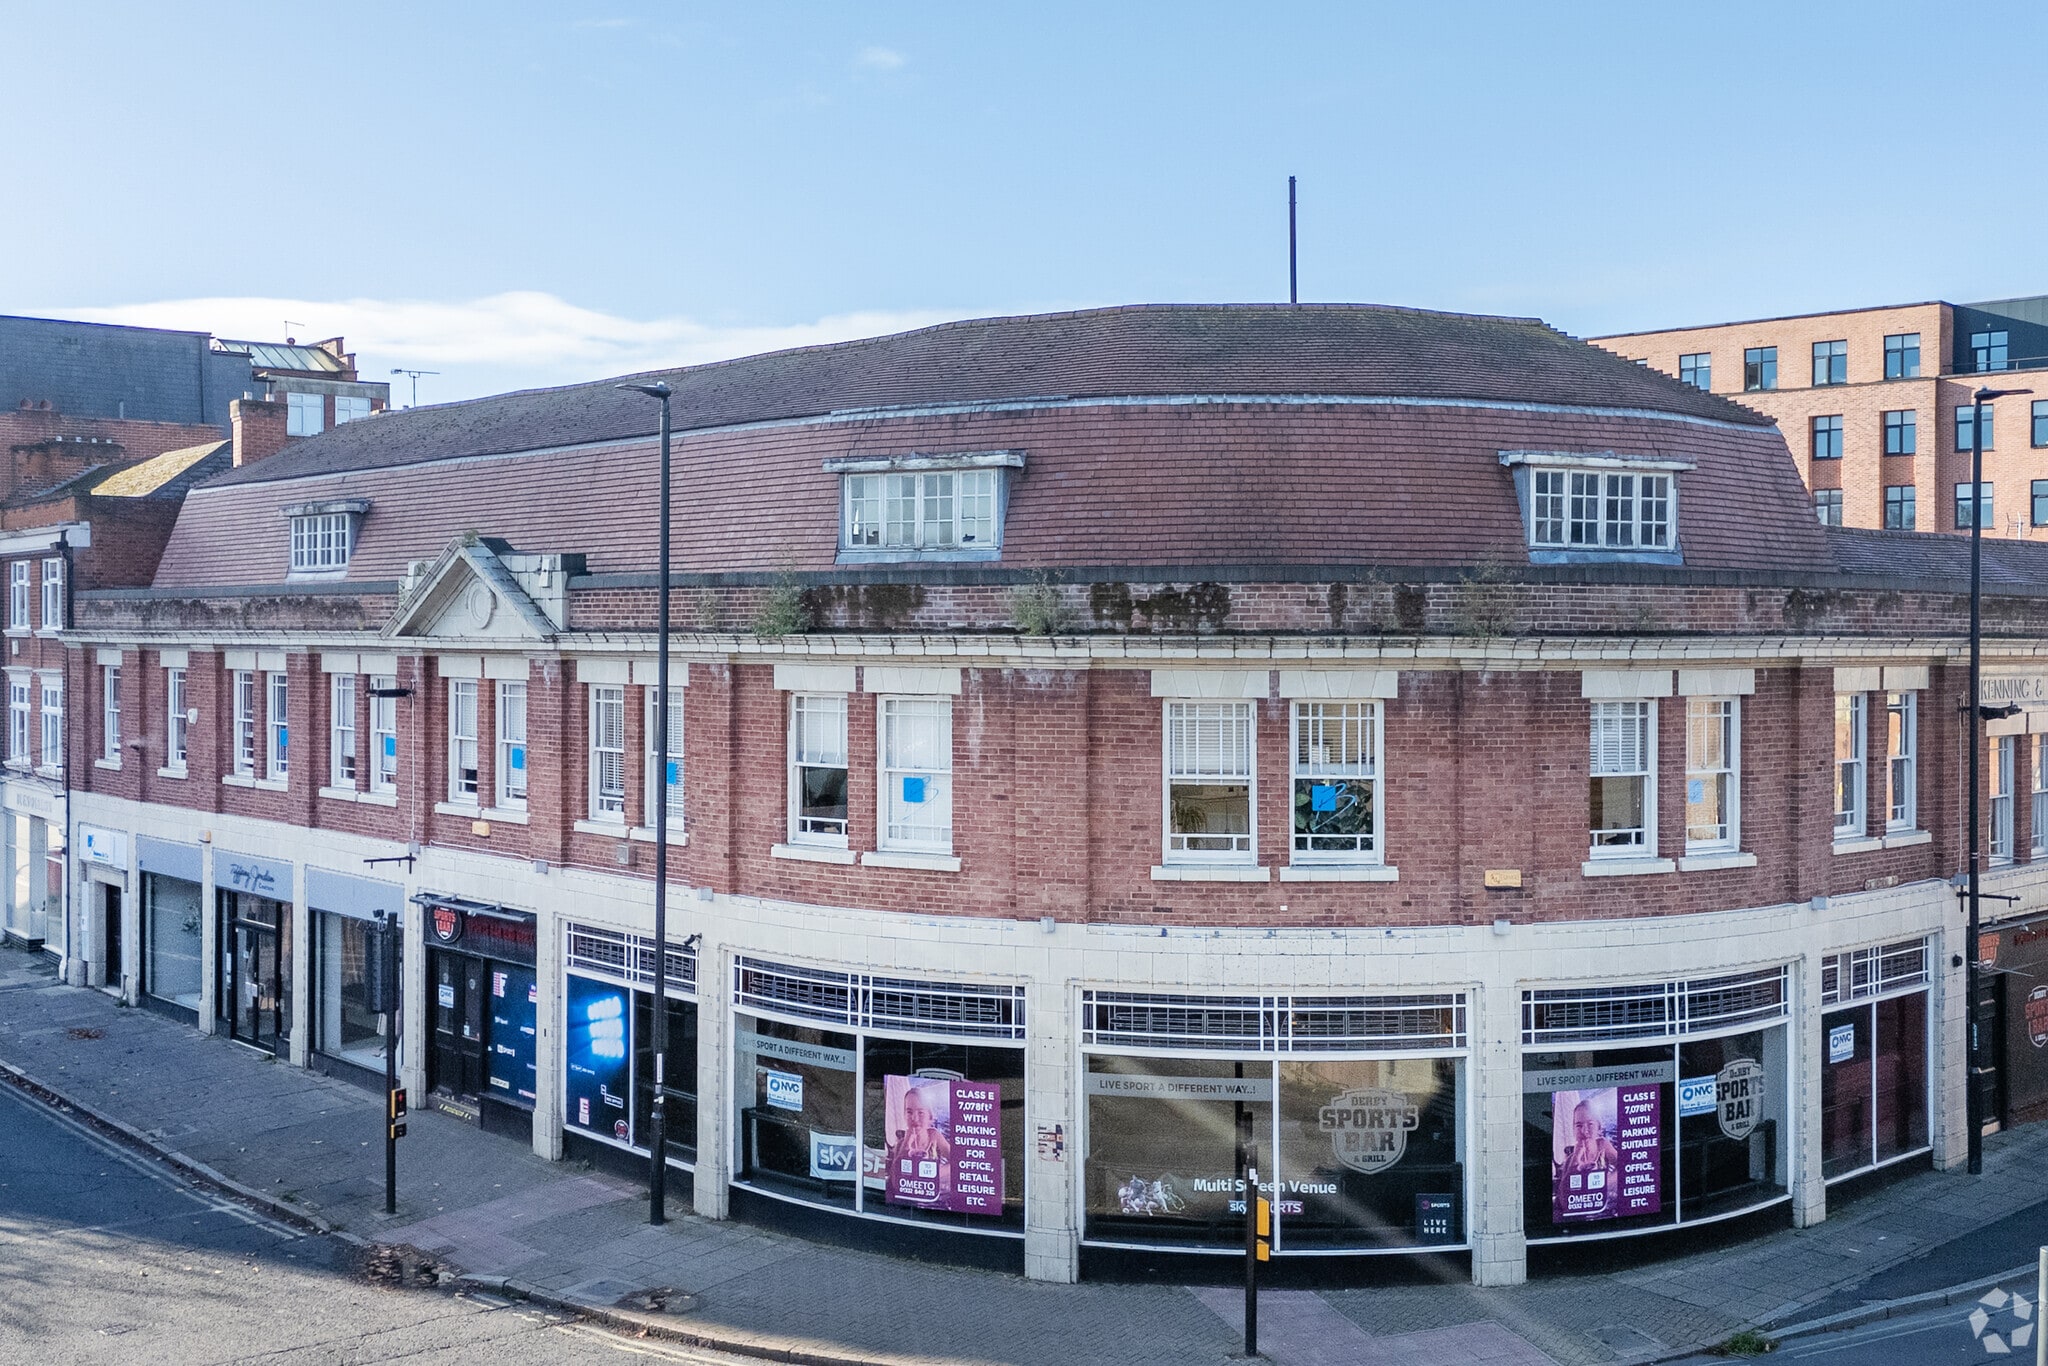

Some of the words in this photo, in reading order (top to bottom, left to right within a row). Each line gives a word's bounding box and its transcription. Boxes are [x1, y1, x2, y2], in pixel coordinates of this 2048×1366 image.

[1980, 679, 2030, 700] KENNING
[2035, 678, 2043, 698] &
[756, 1040, 777, 1052] SPORT
[778, 1045, 784, 1054] A
[784, 1046, 822, 1060] DIFFERENT
[1536, 1076, 1556, 1087] LIVE
[1558, 1074, 1586, 1086] SPORT
[1588, 1074, 1595, 1083] A
[1596, 1070, 1640, 1083] DIFFERENT
[780, 1081, 800, 1093] NVC
[1099, 1080, 1121, 1090] LIVE
[1123, 1081, 1155, 1091] SPORT
[1158, 1083, 1165, 1092] A
[1168, 1083, 1223, 1094] DIFFERENT
[1694, 1084, 1713, 1097] NVC
[956, 1089, 986, 1100] CLASS
[988, 1091, 995, 1100] E
[1623, 1092, 1649, 1102] CLASS
[1649, 1091, 1656, 1100] E
[1351, 1096, 1388, 1106] DERBY
[963, 1113, 988, 1123] WITH
[1321, 1108, 1417, 1129] SPORTS
[1629, 1115, 1651, 1125] WITH
[955, 1124, 996, 1136] PARKING
[1621, 1126, 1657, 1138] PARKING
[955, 1136, 998, 1148] SUITABLE
[1343, 1131, 1396, 1152] BAR
[1621, 1138, 1658, 1150] SUITABLE
[820, 1145, 853, 1170] sky
[966, 1149, 985, 1159] FOR
[1361, 1154, 1387, 1163] GRILL
[1631, 1151, 1648, 1161] FOR
[959, 1160, 994, 1172] OFFICE,
[1625, 1162, 1655, 1173] OFFICE,
[899, 1178, 935, 1190] OMEETO
[959, 1172, 994, 1184] RETAIL,
[1625, 1173, 1654, 1184] RETAIL,
[957, 1183, 996, 1195] LEISURE
[1193, 1178, 1231, 1192] Multi
[1235, 1179, 1286, 1192] Seen
[1288, 1179, 1337, 1194] Venue
[1623, 1185, 1656, 1197] LEISURE
[966, 1196, 987, 1206] ETC.
[1568, 1192, 1603, 1204] OMEETO
[1630, 1198, 1648, 1208] ETC.
[1229, 1201, 1247, 1215] sky
